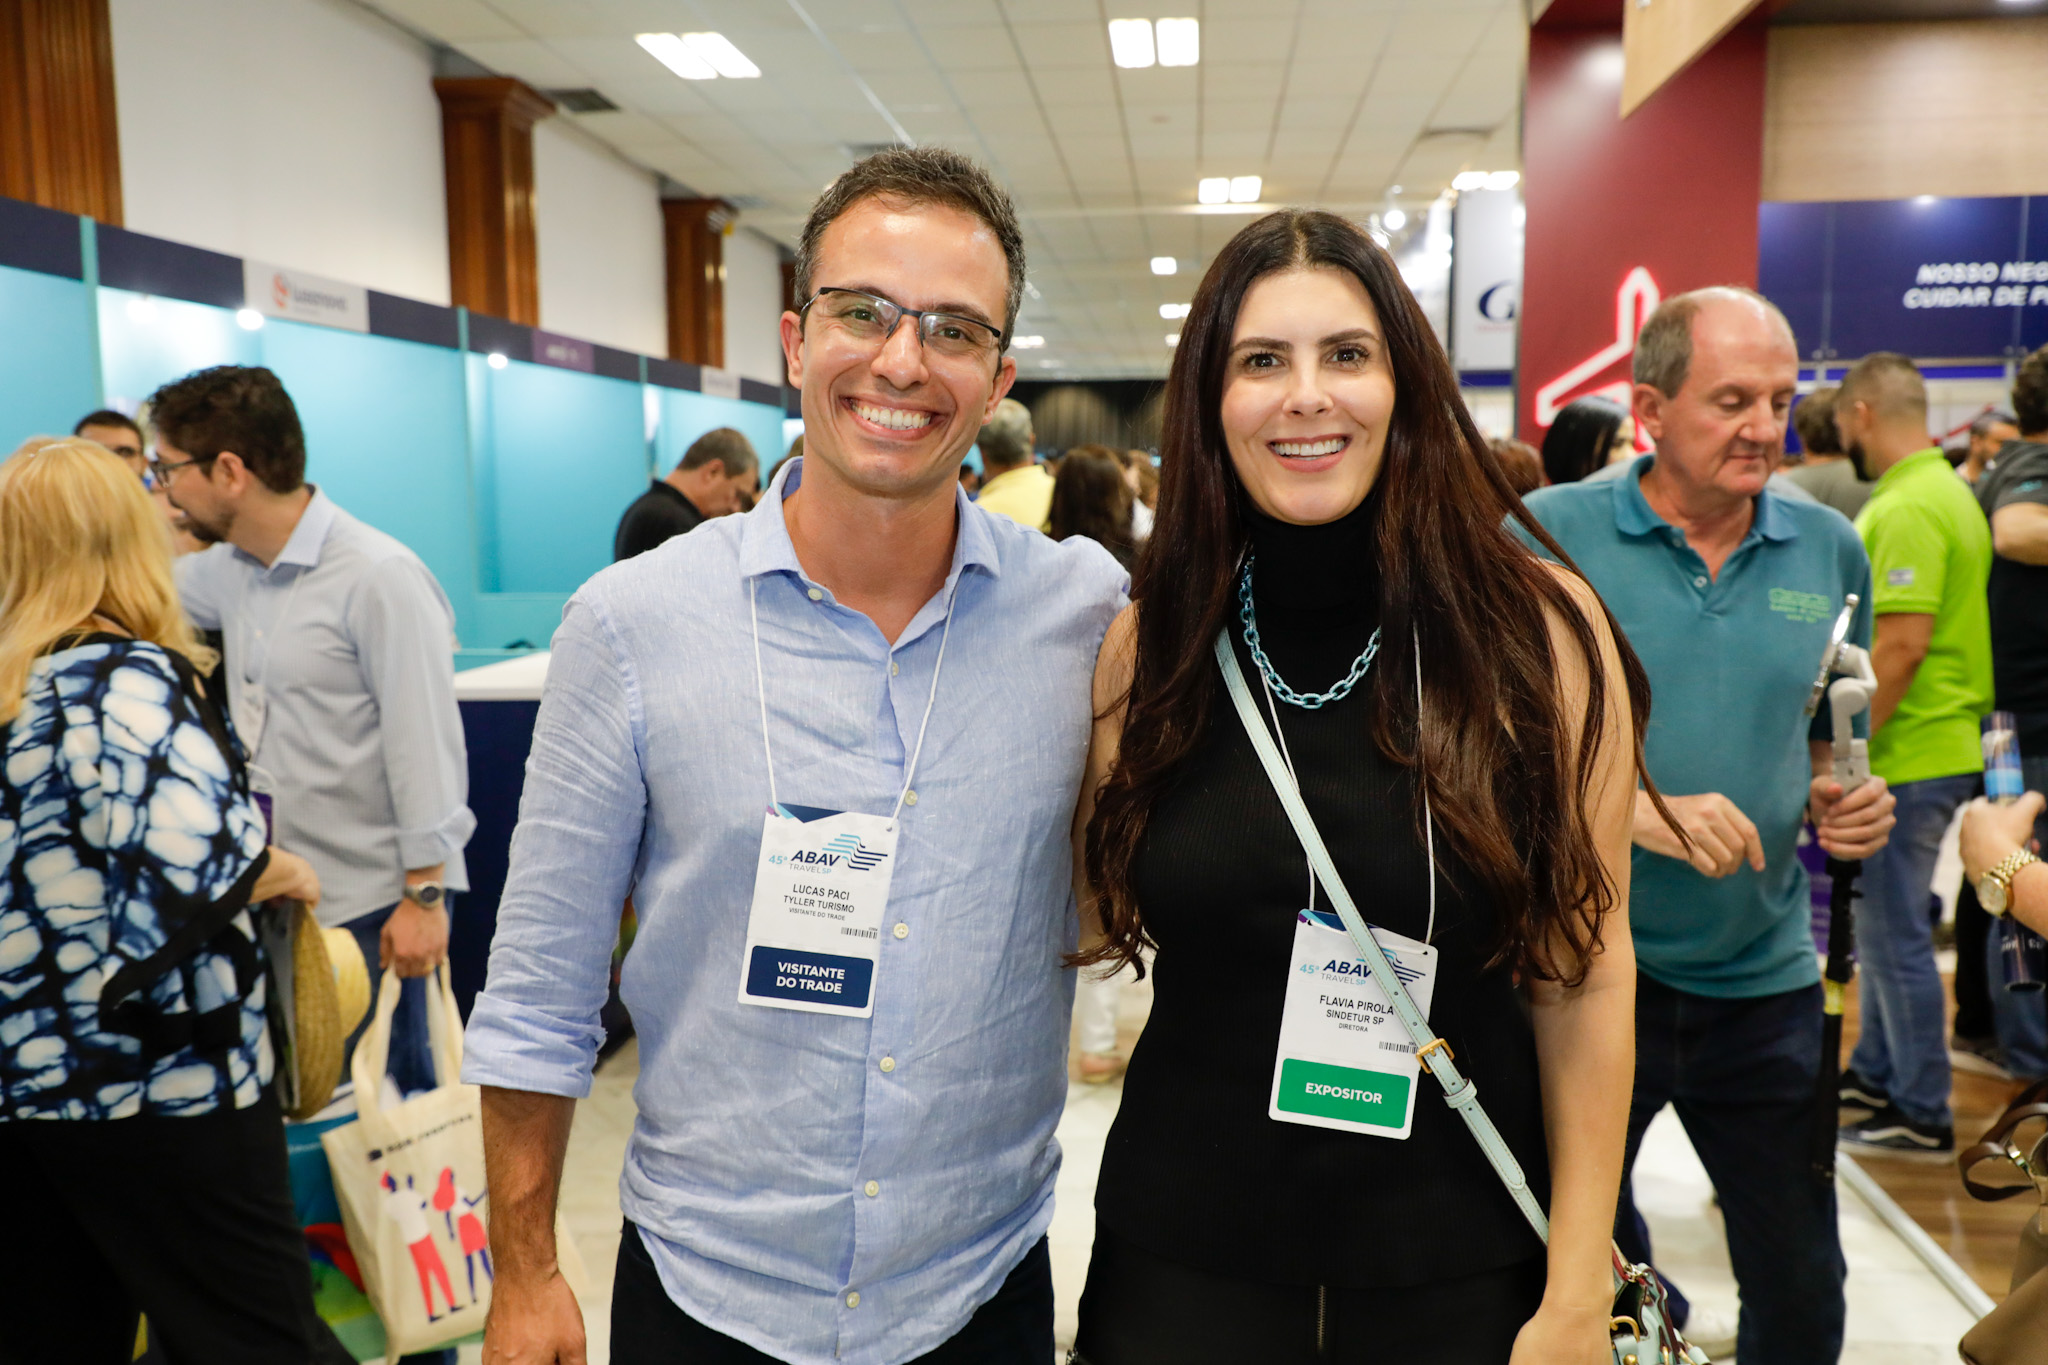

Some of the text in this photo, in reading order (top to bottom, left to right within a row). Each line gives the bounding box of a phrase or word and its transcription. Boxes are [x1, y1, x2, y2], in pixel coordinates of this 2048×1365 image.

[1916, 262, 1999, 285] NOSSO
[1903, 286, 1992, 309] CUIDAR
[1992, 285, 2029, 307] DE
[790, 849, 841, 867] ABAV
[792, 883, 850, 901] LUCAS PACI
[784, 894, 855, 914] TYLLER TURISMO
[789, 907, 817, 917] VISITANTE
[827, 912, 846, 921] TRADE
[777, 961, 846, 980] VISITANTE
[776, 976, 843, 994] DO TRADE
[1319, 994, 1395, 1015] FLAVIA PIROLA
[1326, 1009, 1385, 1025] SINDETUR SP
[1338, 1022, 1369, 1033] DIRETORA
[1304, 1081, 1383, 1105] EXPOSITOR
